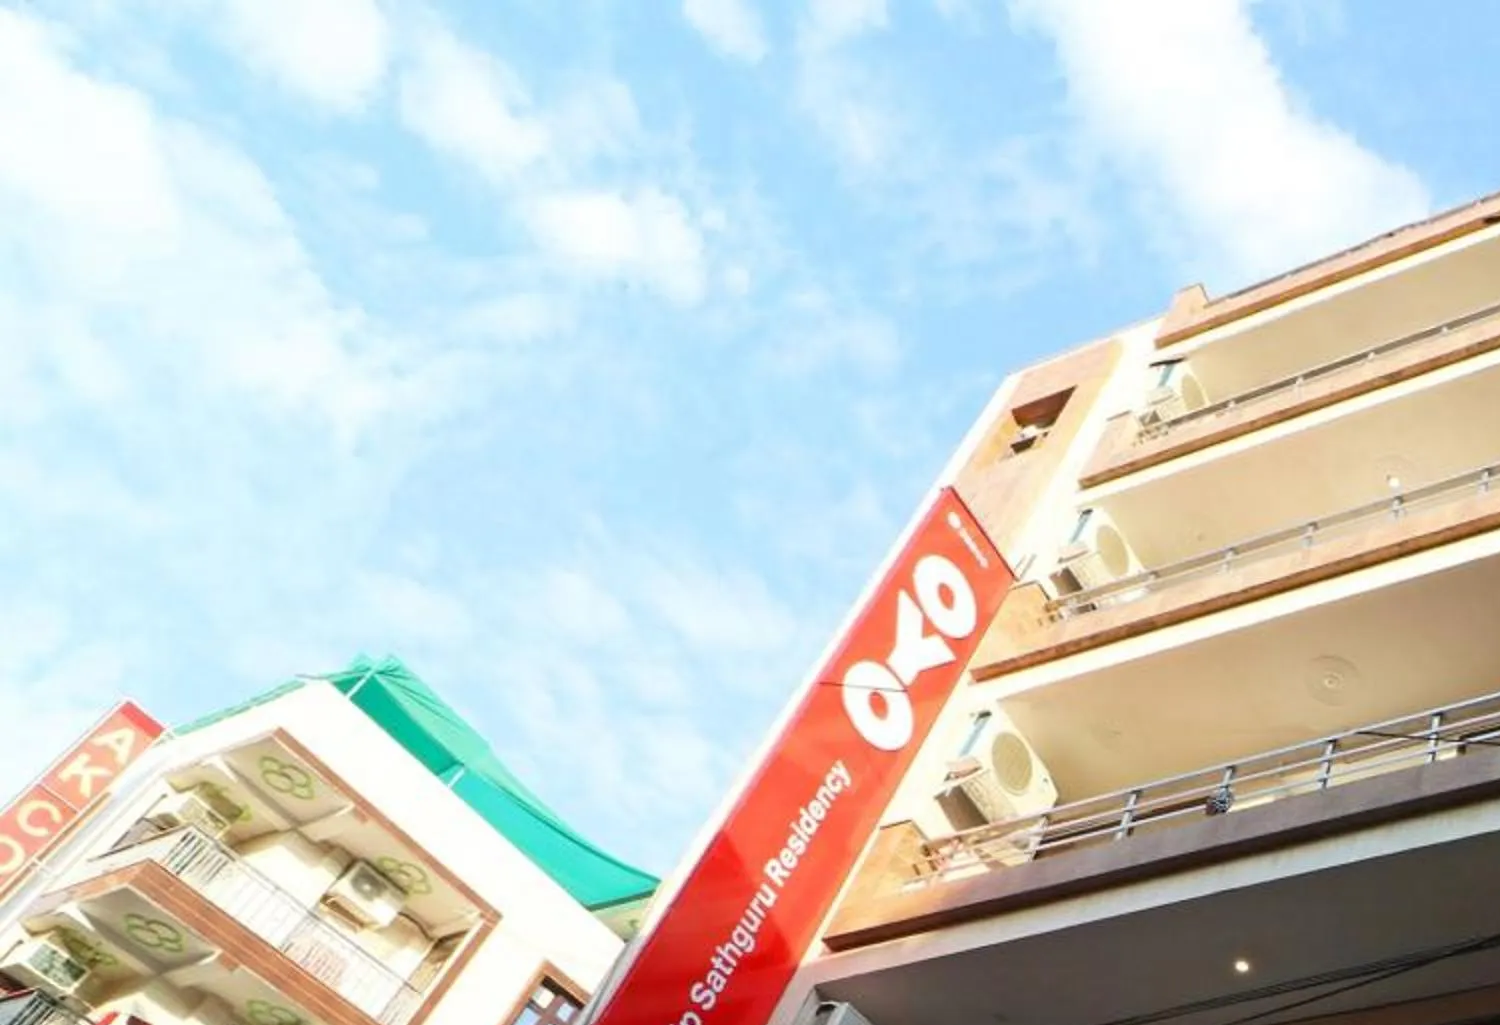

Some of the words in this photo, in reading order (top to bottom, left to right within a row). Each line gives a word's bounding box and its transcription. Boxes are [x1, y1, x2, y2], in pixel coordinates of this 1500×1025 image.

[842, 555, 977, 752] OYO
[689, 883, 778, 1012] Sathguru
[765, 759, 852, 888] Residency
